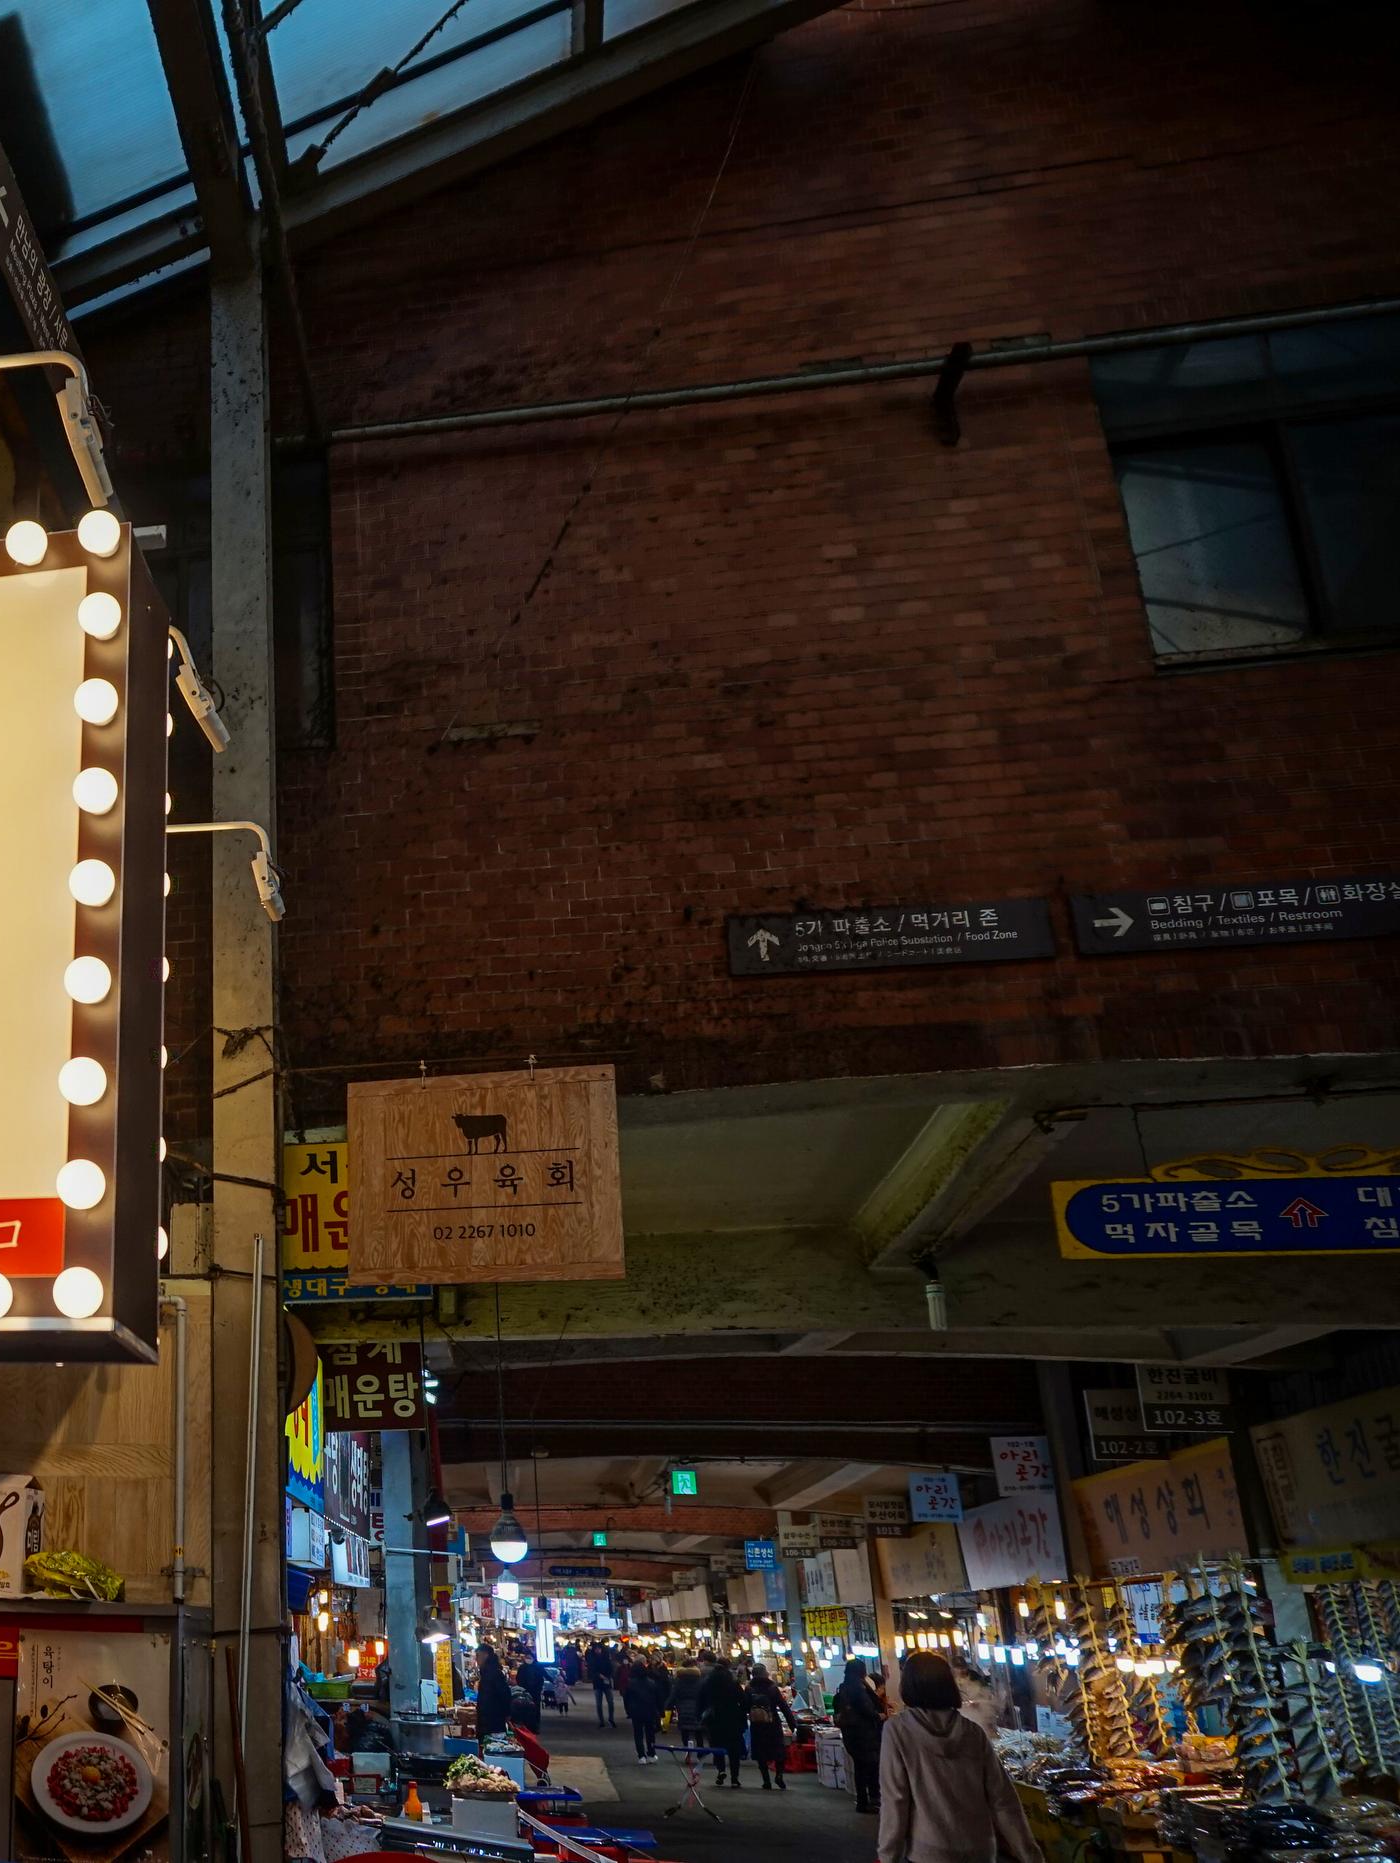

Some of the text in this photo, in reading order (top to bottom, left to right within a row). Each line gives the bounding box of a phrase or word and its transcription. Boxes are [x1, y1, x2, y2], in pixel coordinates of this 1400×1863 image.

[15, 214, 38, 277] 만남의
[1172, 894, 1215, 913] 침구
[1256, 888, 1300, 907] 포목
[832, 916, 892, 935] 파출소
[911, 910, 971, 930] 먹거리
[979, 908, 999, 926] 존
[1151, 908, 1343, 930] Bedding Textiles Restroom
[901, 935, 953, 945] Substation
[966, 931, 991, 941] Food
[992, 930, 1019, 940] Zone
[1101, 1190, 1259, 1213] 5가파출소
[433, 1223, 536, 1240] 02 2267 1010
[1104, 1220, 1264, 1243] 먹자골목
[325, 1372, 419, 1419] 매운탕
[1153, 1410, 1224, 1425] 102-3호
